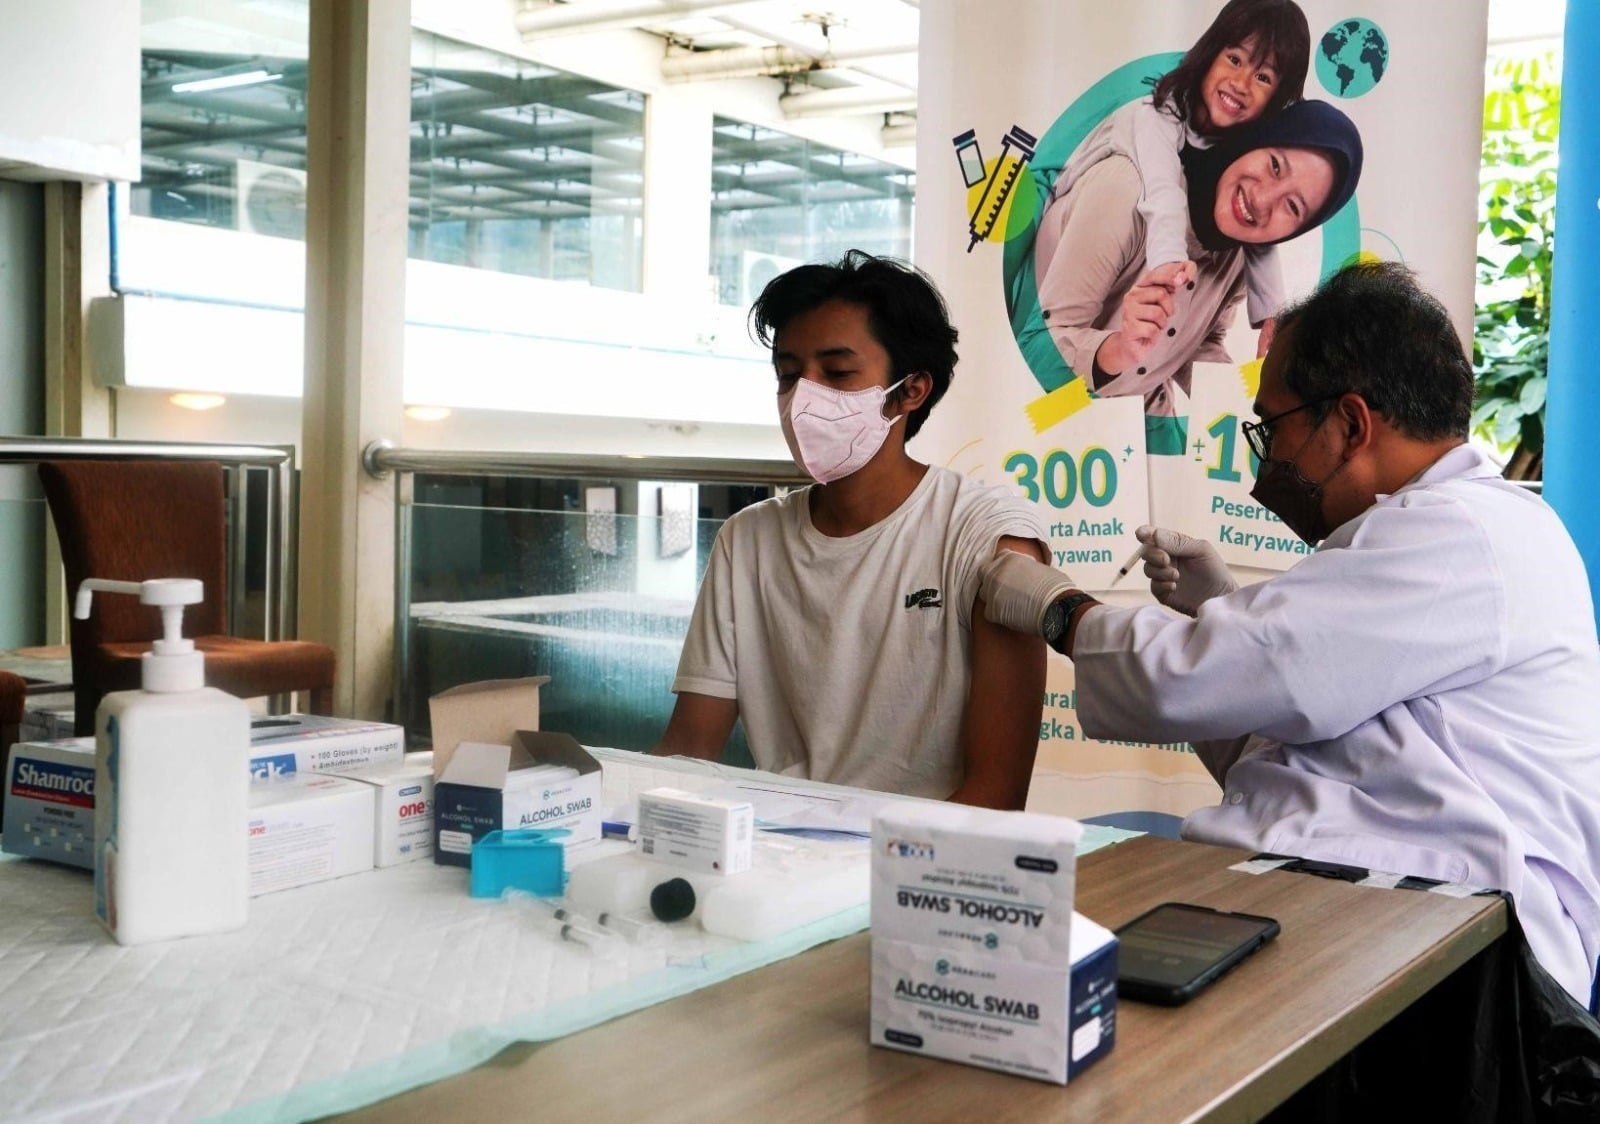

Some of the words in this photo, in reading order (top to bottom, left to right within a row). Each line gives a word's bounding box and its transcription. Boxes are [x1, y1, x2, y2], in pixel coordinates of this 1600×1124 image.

[1003, 446, 1118, 509] 300
[1077, 518, 1124, 537] Anak
[333, 748, 358, 758] Gloves
[520, 805, 565, 826] ALCOHOL
[566, 798, 592, 814] SWAB
[897, 890, 950, 913] SWAB
[955, 898, 1044, 928] ALCOHOL
[895, 979, 979, 1010] ALCOHOL
[984, 996, 1040, 1020] SWAB
